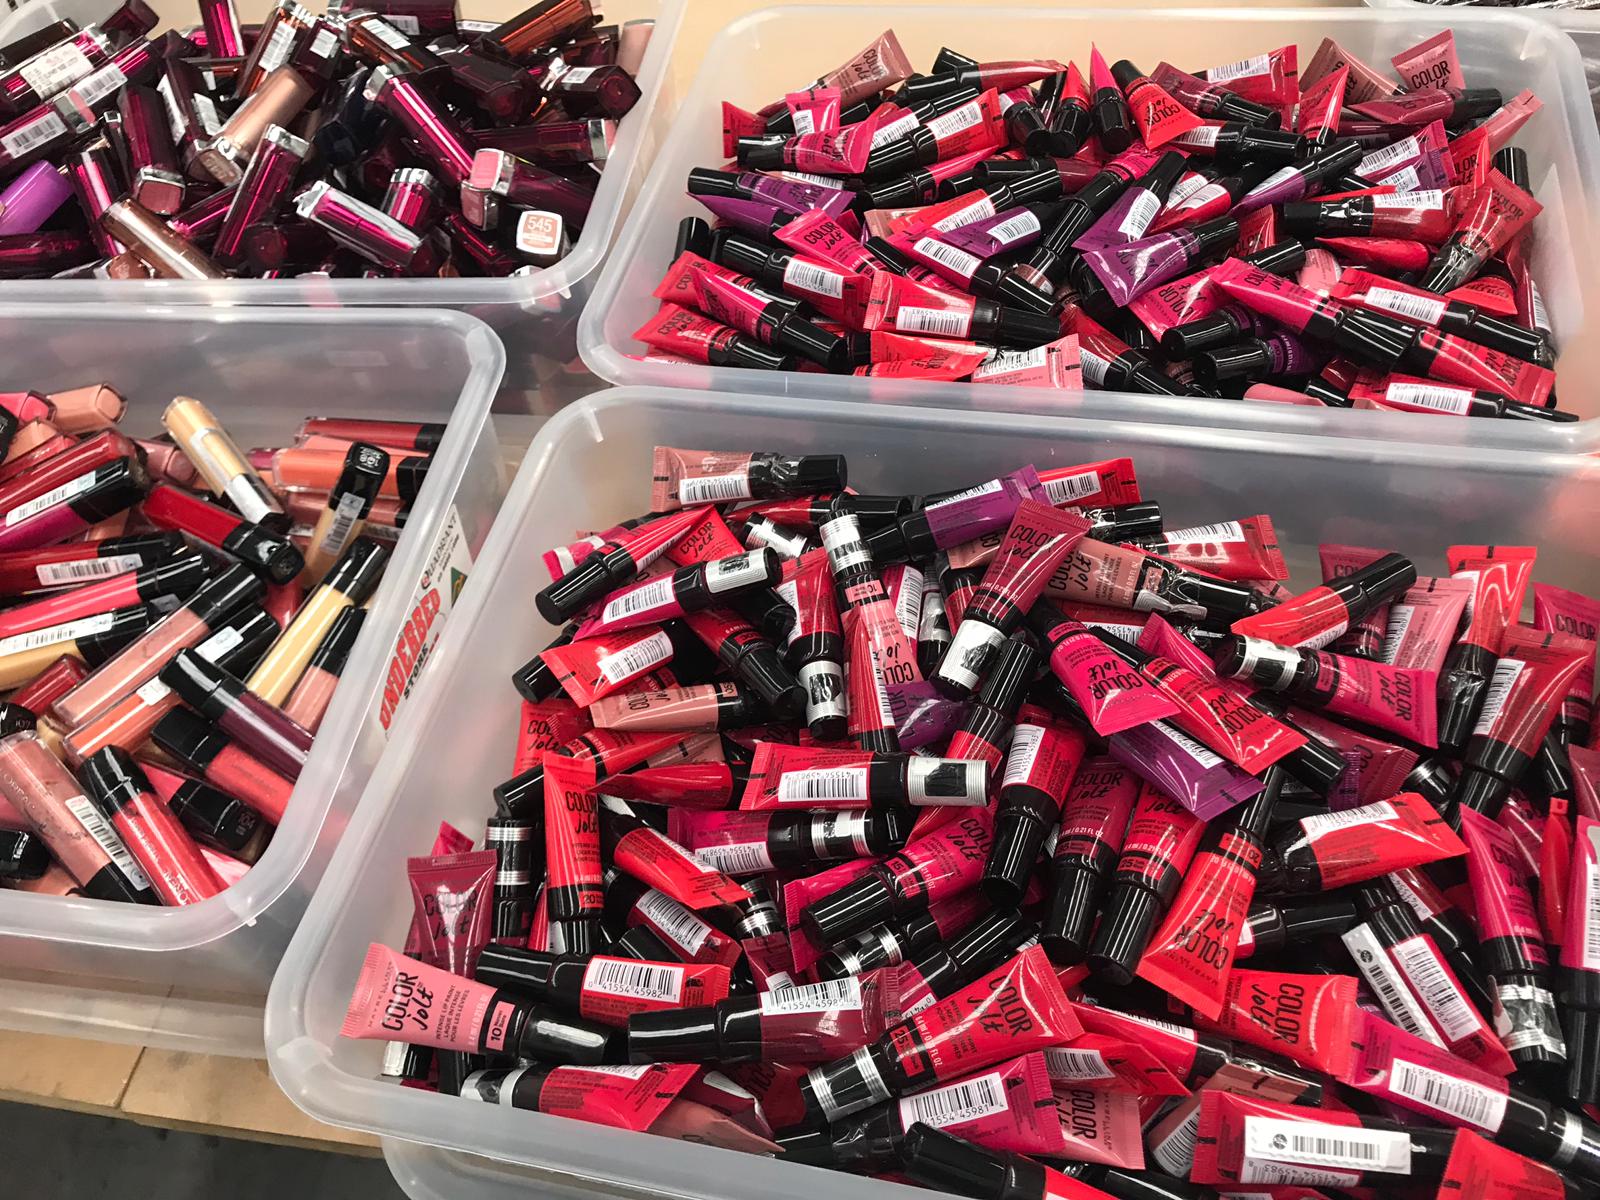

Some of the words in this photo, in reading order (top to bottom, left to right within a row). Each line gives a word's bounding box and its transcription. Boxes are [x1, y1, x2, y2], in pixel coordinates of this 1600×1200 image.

[851, 62, 872, 81] jolt
[1411, 60, 1451, 91] COLOR
[1143, 104, 1181, 125] COLOR
[526, 214, 553, 235] 545
[803, 220, 839, 246] COLOR
[822, 230, 846, 250] jolt
[1158, 284, 1193, 319] COLOR
[679, 521, 715, 556] COLOR
[693, 533, 715, 559] jolt
[1048, 548, 1077, 592] COLO
[1069, 553, 1093, 591] jolt
[1107, 625, 1132, 635] 41554
[1555, 613, 1597, 640] COLOR
[379, 588, 441, 730] UNDERBED
[1087, 659, 1119, 681] jolt
[882, 660, 915, 685] COL
[1092, 672, 1144, 700] COLOR
[1375, 670, 1399, 709] jolt
[1394, 670, 1413, 722] COLOR
[1208, 691, 1232, 716] jolt
[527, 720, 551, 735] COL
[1220, 703, 1264, 735] COLOR
[528, 735, 558, 752] jolt
[1071, 772, 1124, 787] COLOR
[1073, 784, 1111, 800] jolt
[565, 790, 598, 813] COLOR
[1144, 799, 1183, 815] jolt
[575, 814, 598, 835] jolt
[960, 817, 992, 854] COLO
[1074, 826, 1086, 834] 0.21
[1087, 827, 1094, 835] FL
[705, 848, 728, 857] 45981
[946, 833, 980, 862] jolt
[891, 859, 902, 873] 15
[1120, 858, 1134, 870] 25
[584, 895, 596, 904] 20
[1194, 908, 1235, 933] jolt
[1175, 924, 1231, 970] COLOR
[1405, 961, 1427, 992] 41554
[381, 970, 419, 1032] COLOR
[455, 988, 470, 1015] LÈVRES
[601, 983, 631, 995] 41554
[633, 987, 663, 999] 45982
[405, 986, 434, 1031] jolt
[433, 1014, 448, 1040] INTENSE
[444, 984, 456, 1006] PAINT
[446, 990, 462, 1019] INTENSE
[780, 1002, 811, 1011] 41554
[988, 974, 1033, 1038] COLOR
[1249, 983, 1271, 1027] jolt
[1272, 982, 1305, 1045] COLOR
[441, 1018, 454, 1038] LAQUE
[453, 1014, 462, 1025] LES
[448, 1026, 459, 1043] POUR
[489, 1026, 503, 1042] 10
[894, 1030, 906, 1046] 25
[924, 1115, 956, 1127] 41554
[959, 1104, 989, 1118] 45981
[1070, 1088, 1097, 1141] COLOR
[1264, 1165, 1299, 1178] 45983
